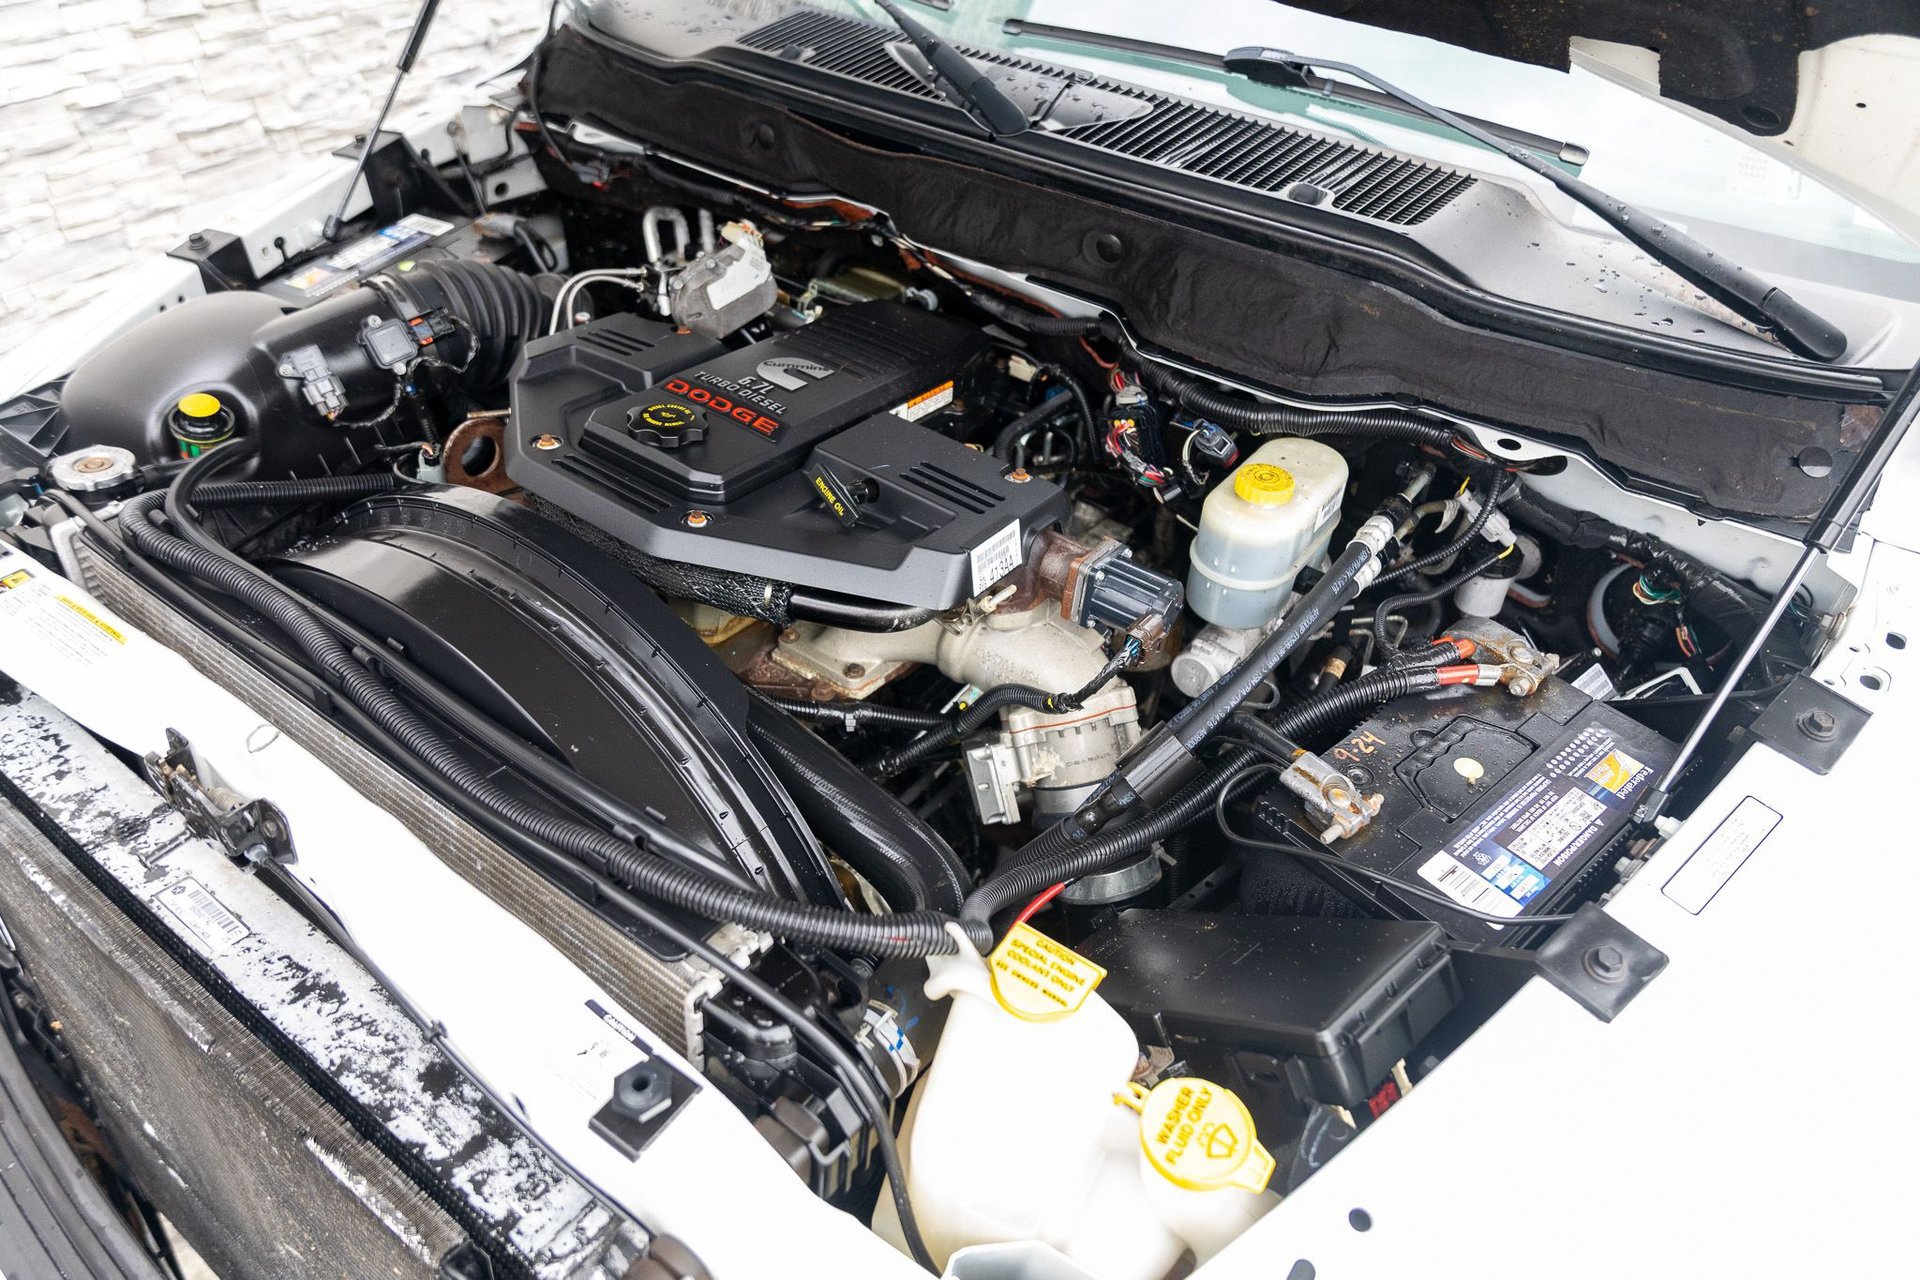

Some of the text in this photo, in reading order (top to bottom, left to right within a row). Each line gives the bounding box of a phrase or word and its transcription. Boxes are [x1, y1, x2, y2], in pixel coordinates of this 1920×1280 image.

[737, 376, 775, 394] 6.7L
[763, 360, 831, 372] Cummins
[664, 378, 779, 436] DODGE
[694, 371, 789, 415] TURBO DIESEL
[815, 476, 845, 517] ENGINE OIL
[1208, 712, 1226, 729] 3426
[1615, 765, 1653, 799] Federated
[1553, 824, 1597, 866] DANGER/POISON
[1007, 949, 1075, 992] COOLANT ONLY
[1010, 938, 1085, 986] SPECIAL ENGINE
[1036, 939, 1075, 966] CAUTION
[602, 1012, 636, 1042] CAUTION
[1155, 1086, 1194, 1145] WASHER
[1164, 1086, 1213, 1166] FLUID ONLY
